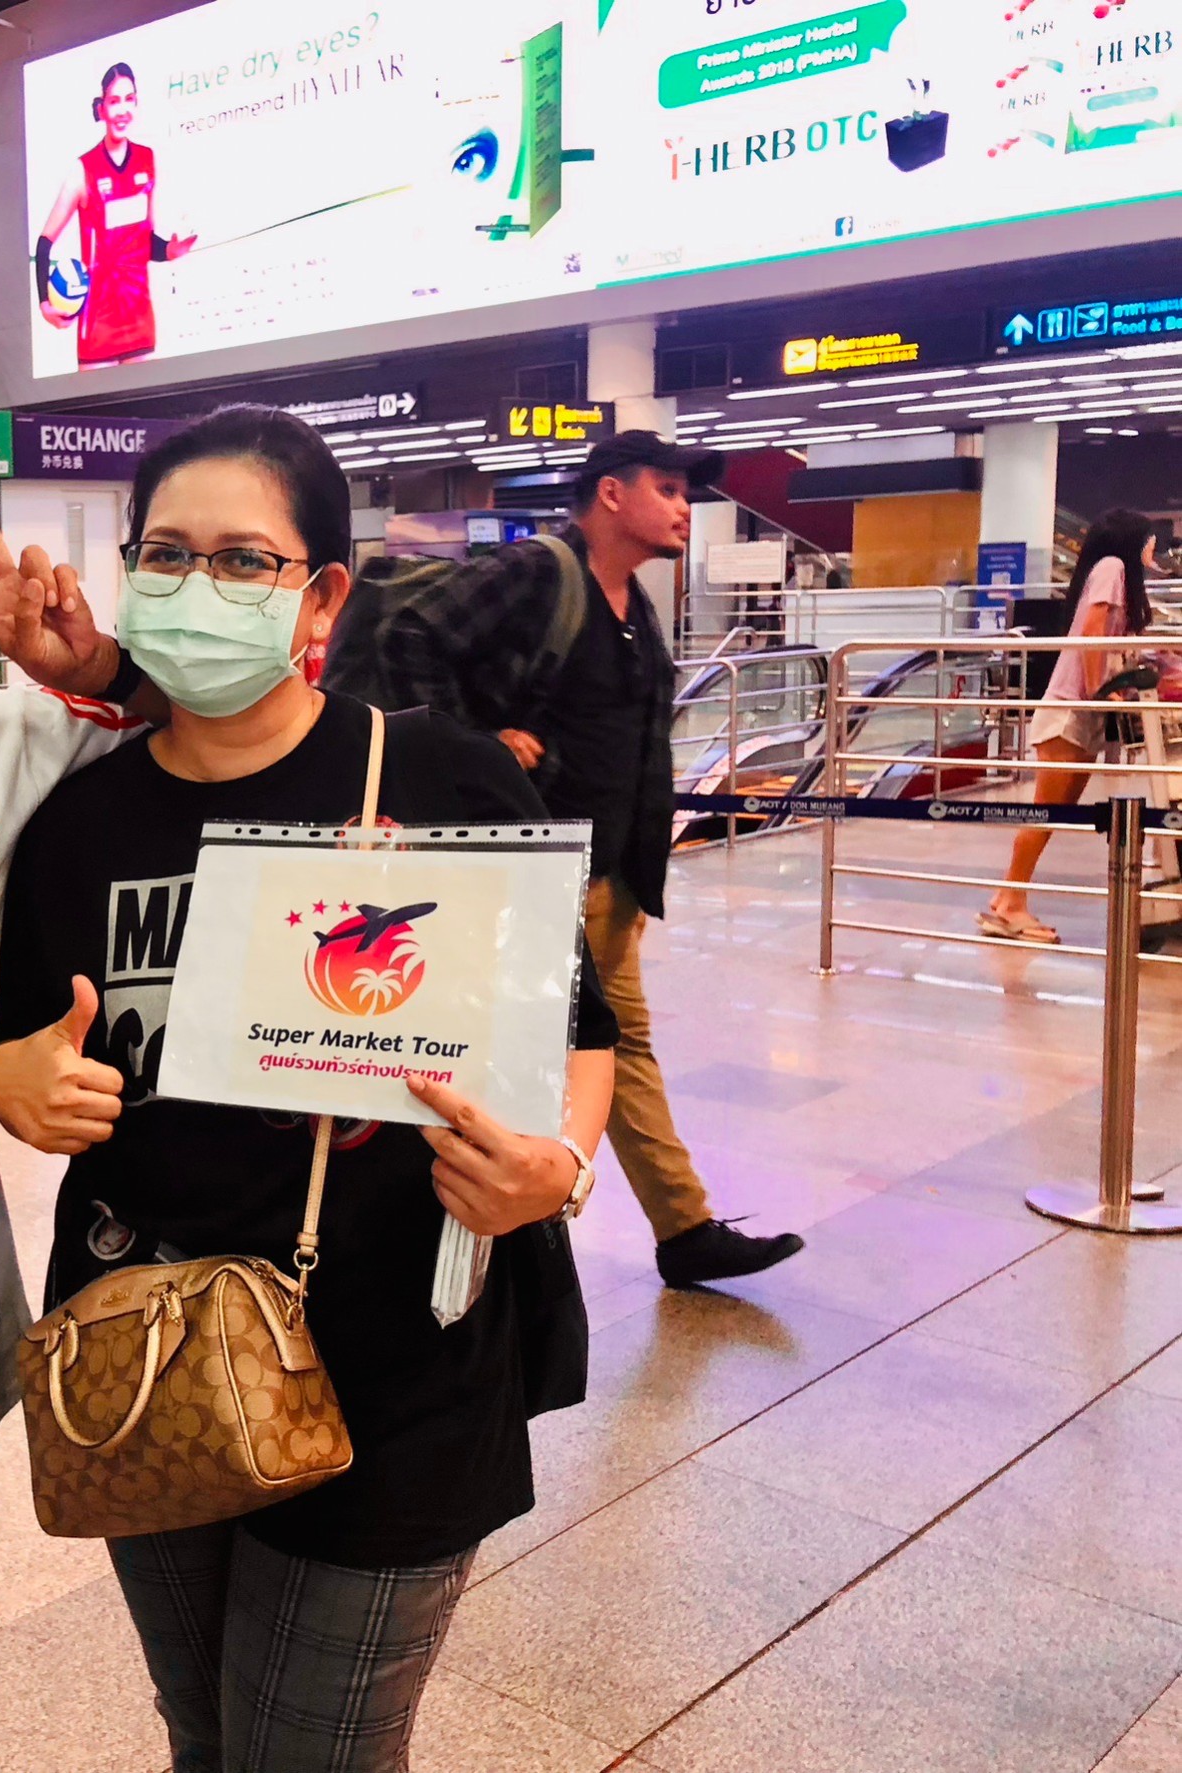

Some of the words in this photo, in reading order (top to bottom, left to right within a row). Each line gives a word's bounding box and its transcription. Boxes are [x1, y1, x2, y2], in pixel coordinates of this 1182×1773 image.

[168, 64, 229, 99] Have
[242, 50, 282, 79] dry
[696, 49, 740, 70] Prime
[806, 110, 878, 152] OTC
[1112, 319, 1147, 336] Food
[40, 425, 146, 453] EXCHANGE
[248, 1023, 314, 1047] Super
[320, 1029, 403, 1052] Market
[412, 1036, 469, 1058] Tour
